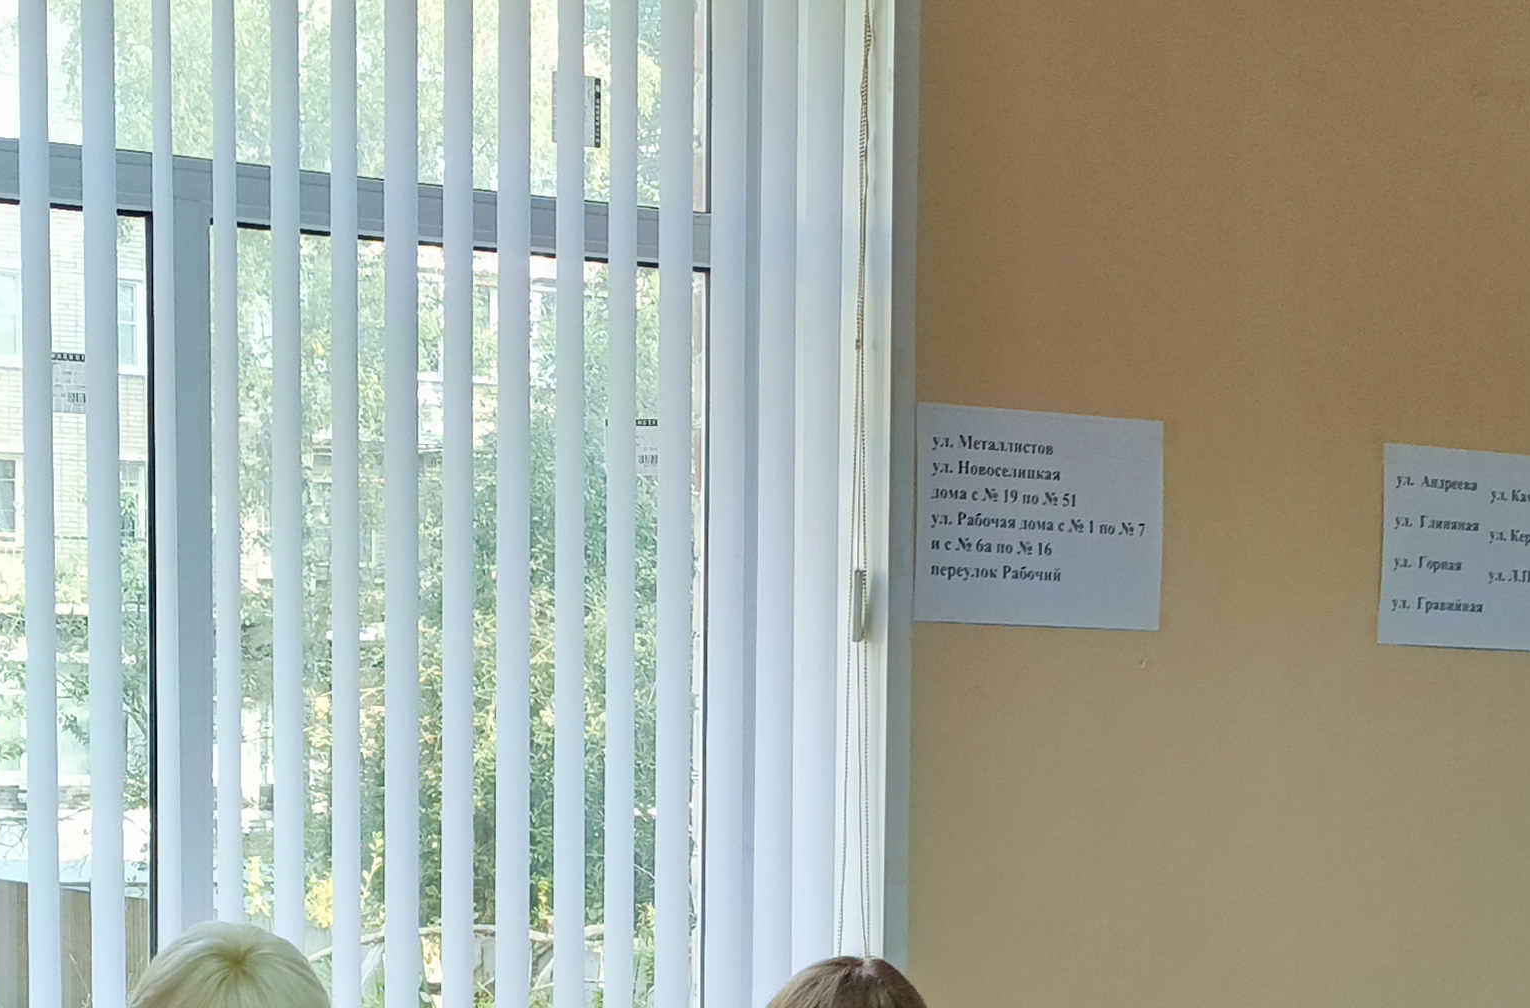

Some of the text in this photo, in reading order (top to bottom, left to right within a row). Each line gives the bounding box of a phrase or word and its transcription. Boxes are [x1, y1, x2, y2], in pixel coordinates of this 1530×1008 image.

[931, 433, 1054, 456] ул. Металлистов
[931, 462, 954, 477] ул.
[930, 487, 968, 501] дома
[970, 490, 979, 502] с
[1003, 488, 1018, 504] 19
[1022, 494, 1040, 506] по
[1062, 492, 1076, 508] 51
[930, 513, 953, 529] ул.
[957, 511, 1016, 529] Рабочая
[1018, 519, 1054, 532] дома
[1057, 521, 1066, 533] с
[1089, 519, 1094, 534] 1
[1099, 524, 1116, 536] по
[1138, 522, 1146, 537] 7
[930, 539, 941, 551] и
[943, 540, 953, 551] с
[975, 538, 992, 553] 6а
[996, 543, 1014, 555] по
[1037, 542, 1053, 557] 16
[930, 564, 1062, 582] переулок Рабочий
